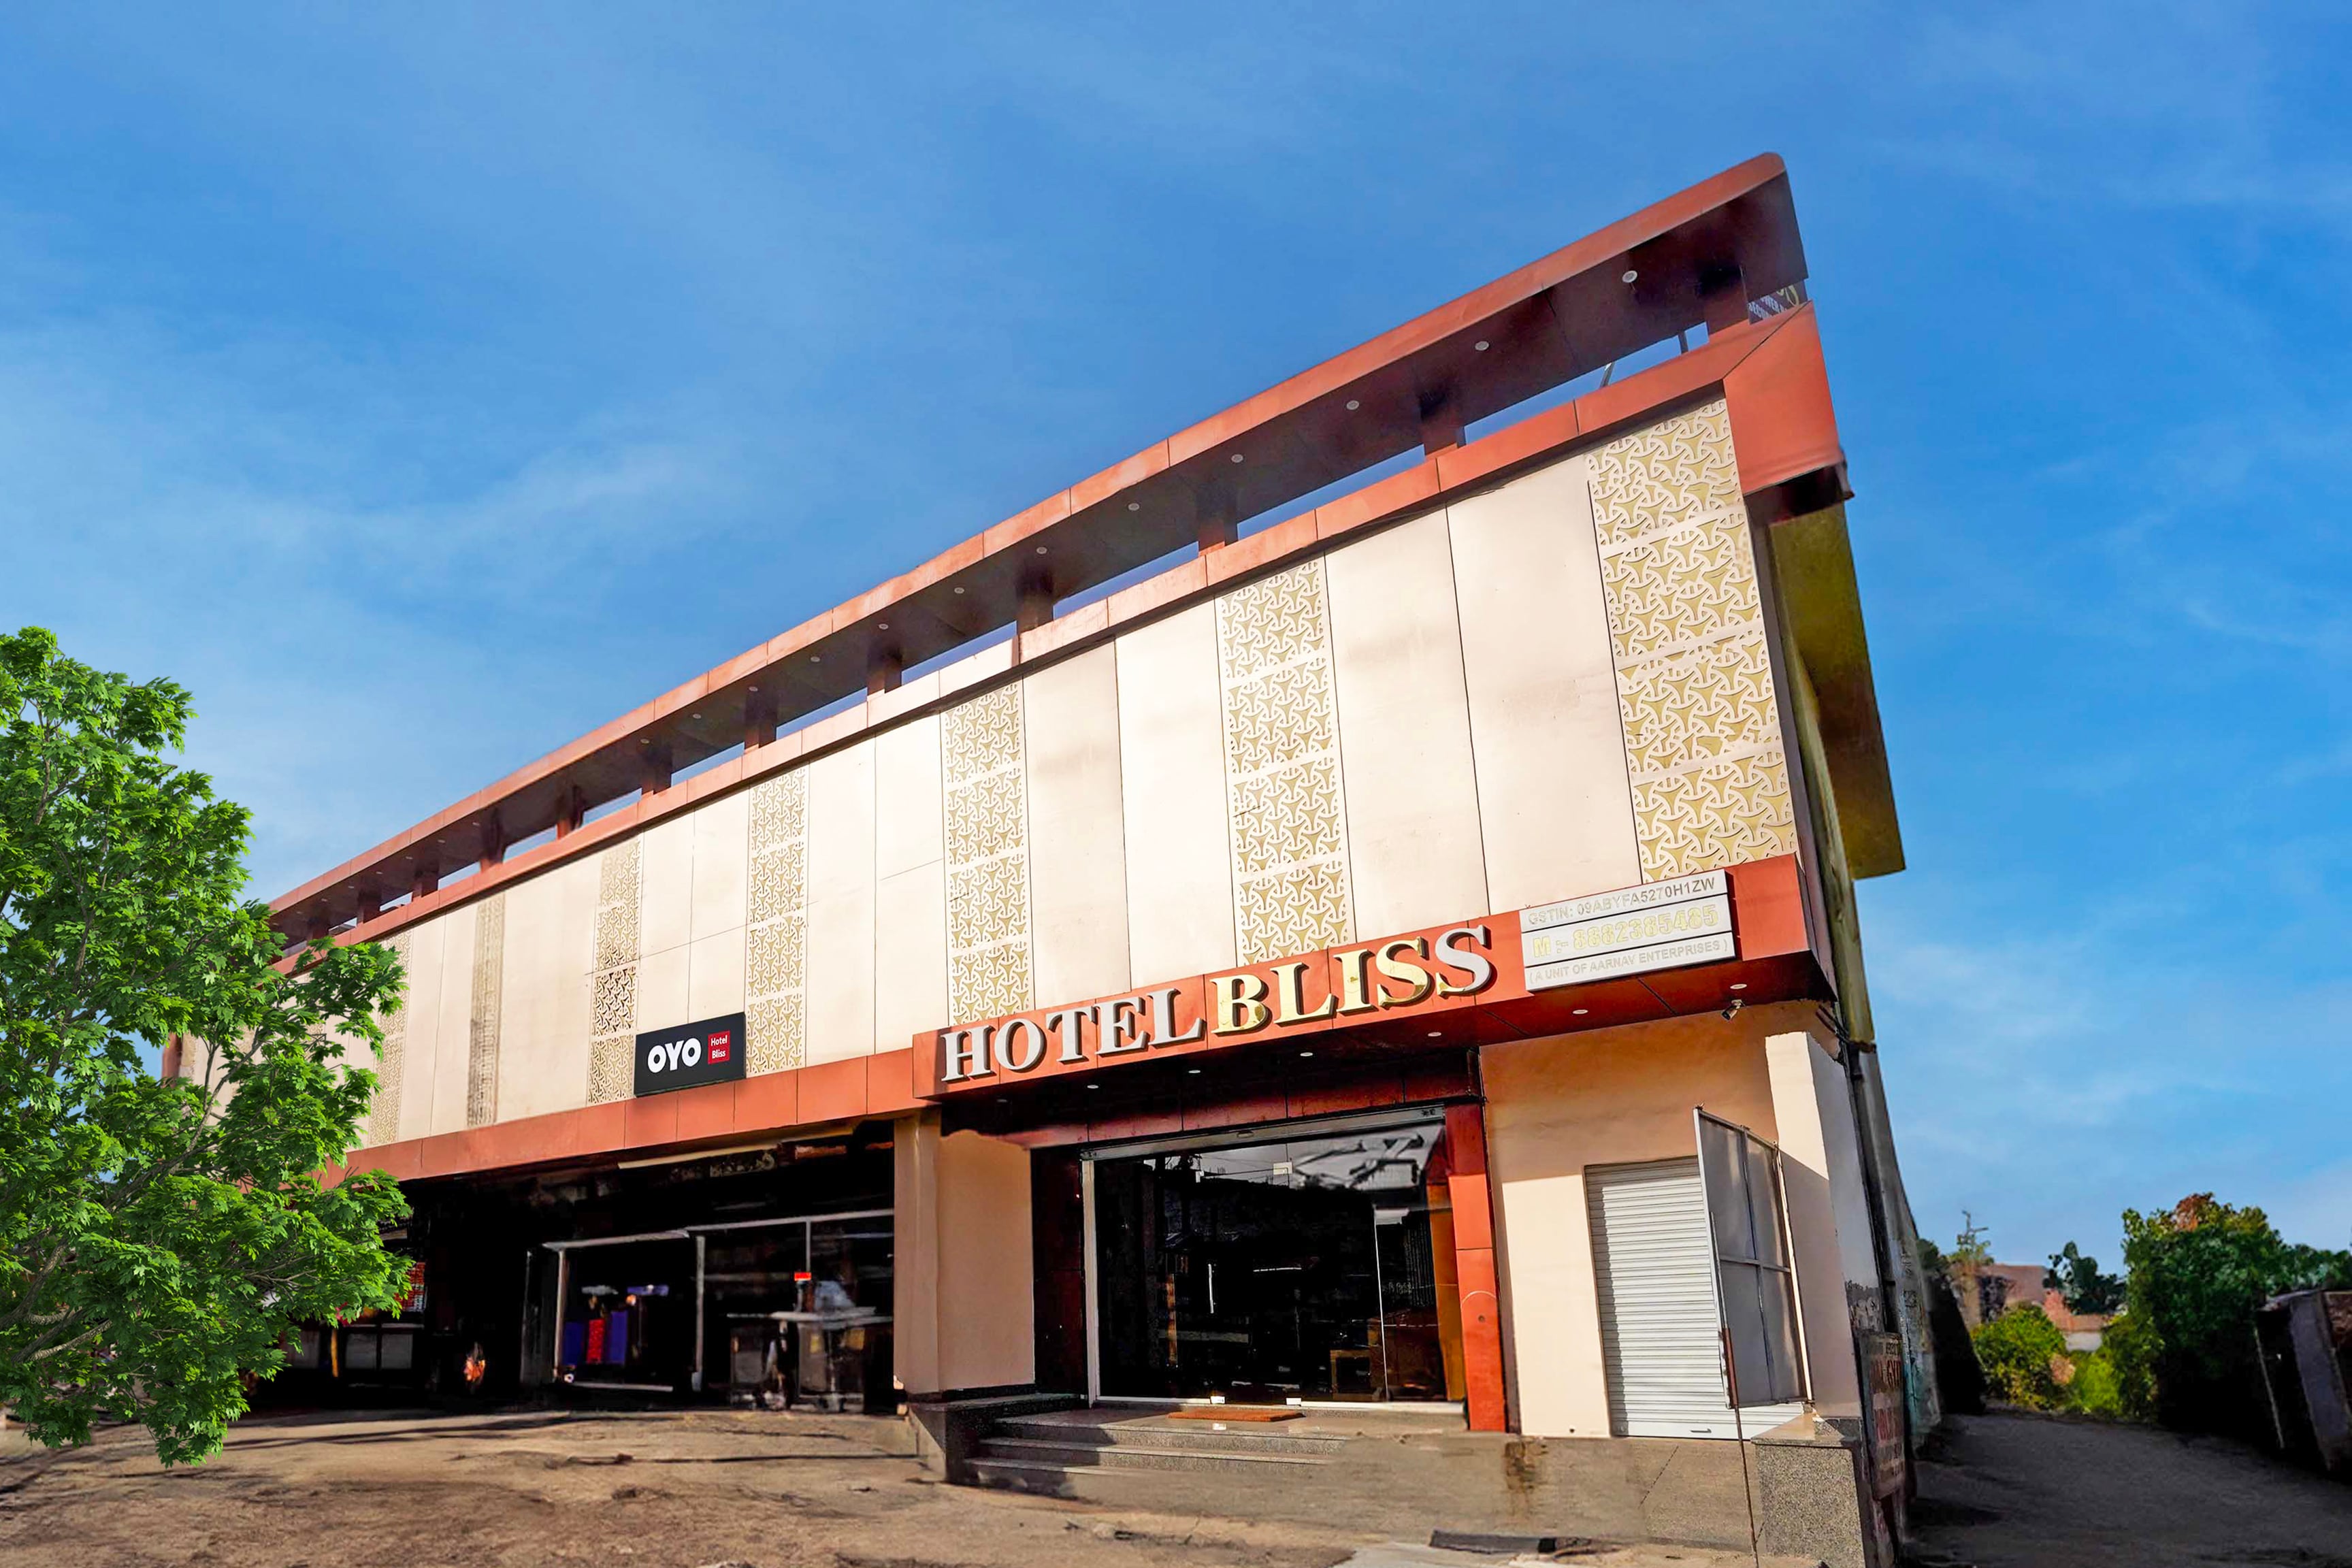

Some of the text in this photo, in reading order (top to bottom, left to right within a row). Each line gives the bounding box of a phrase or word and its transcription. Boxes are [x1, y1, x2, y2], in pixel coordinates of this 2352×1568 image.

[1529, 907, 1573, 925] GSTIN:
[1545, 964, 1572, 979] UNIT
[1573, 962, 1588, 975] OF
[1590, 956, 1636, 971] AARNAV
[1639, 940, 1720, 964] ENTERPRISES
[940, 925, 1492, 1082] HOTEL BLISS
[710, 1034, 728, 1047] Hotel
[647, 1038, 702, 1073] OYO
[712, 1049, 726, 1059] Bliss
